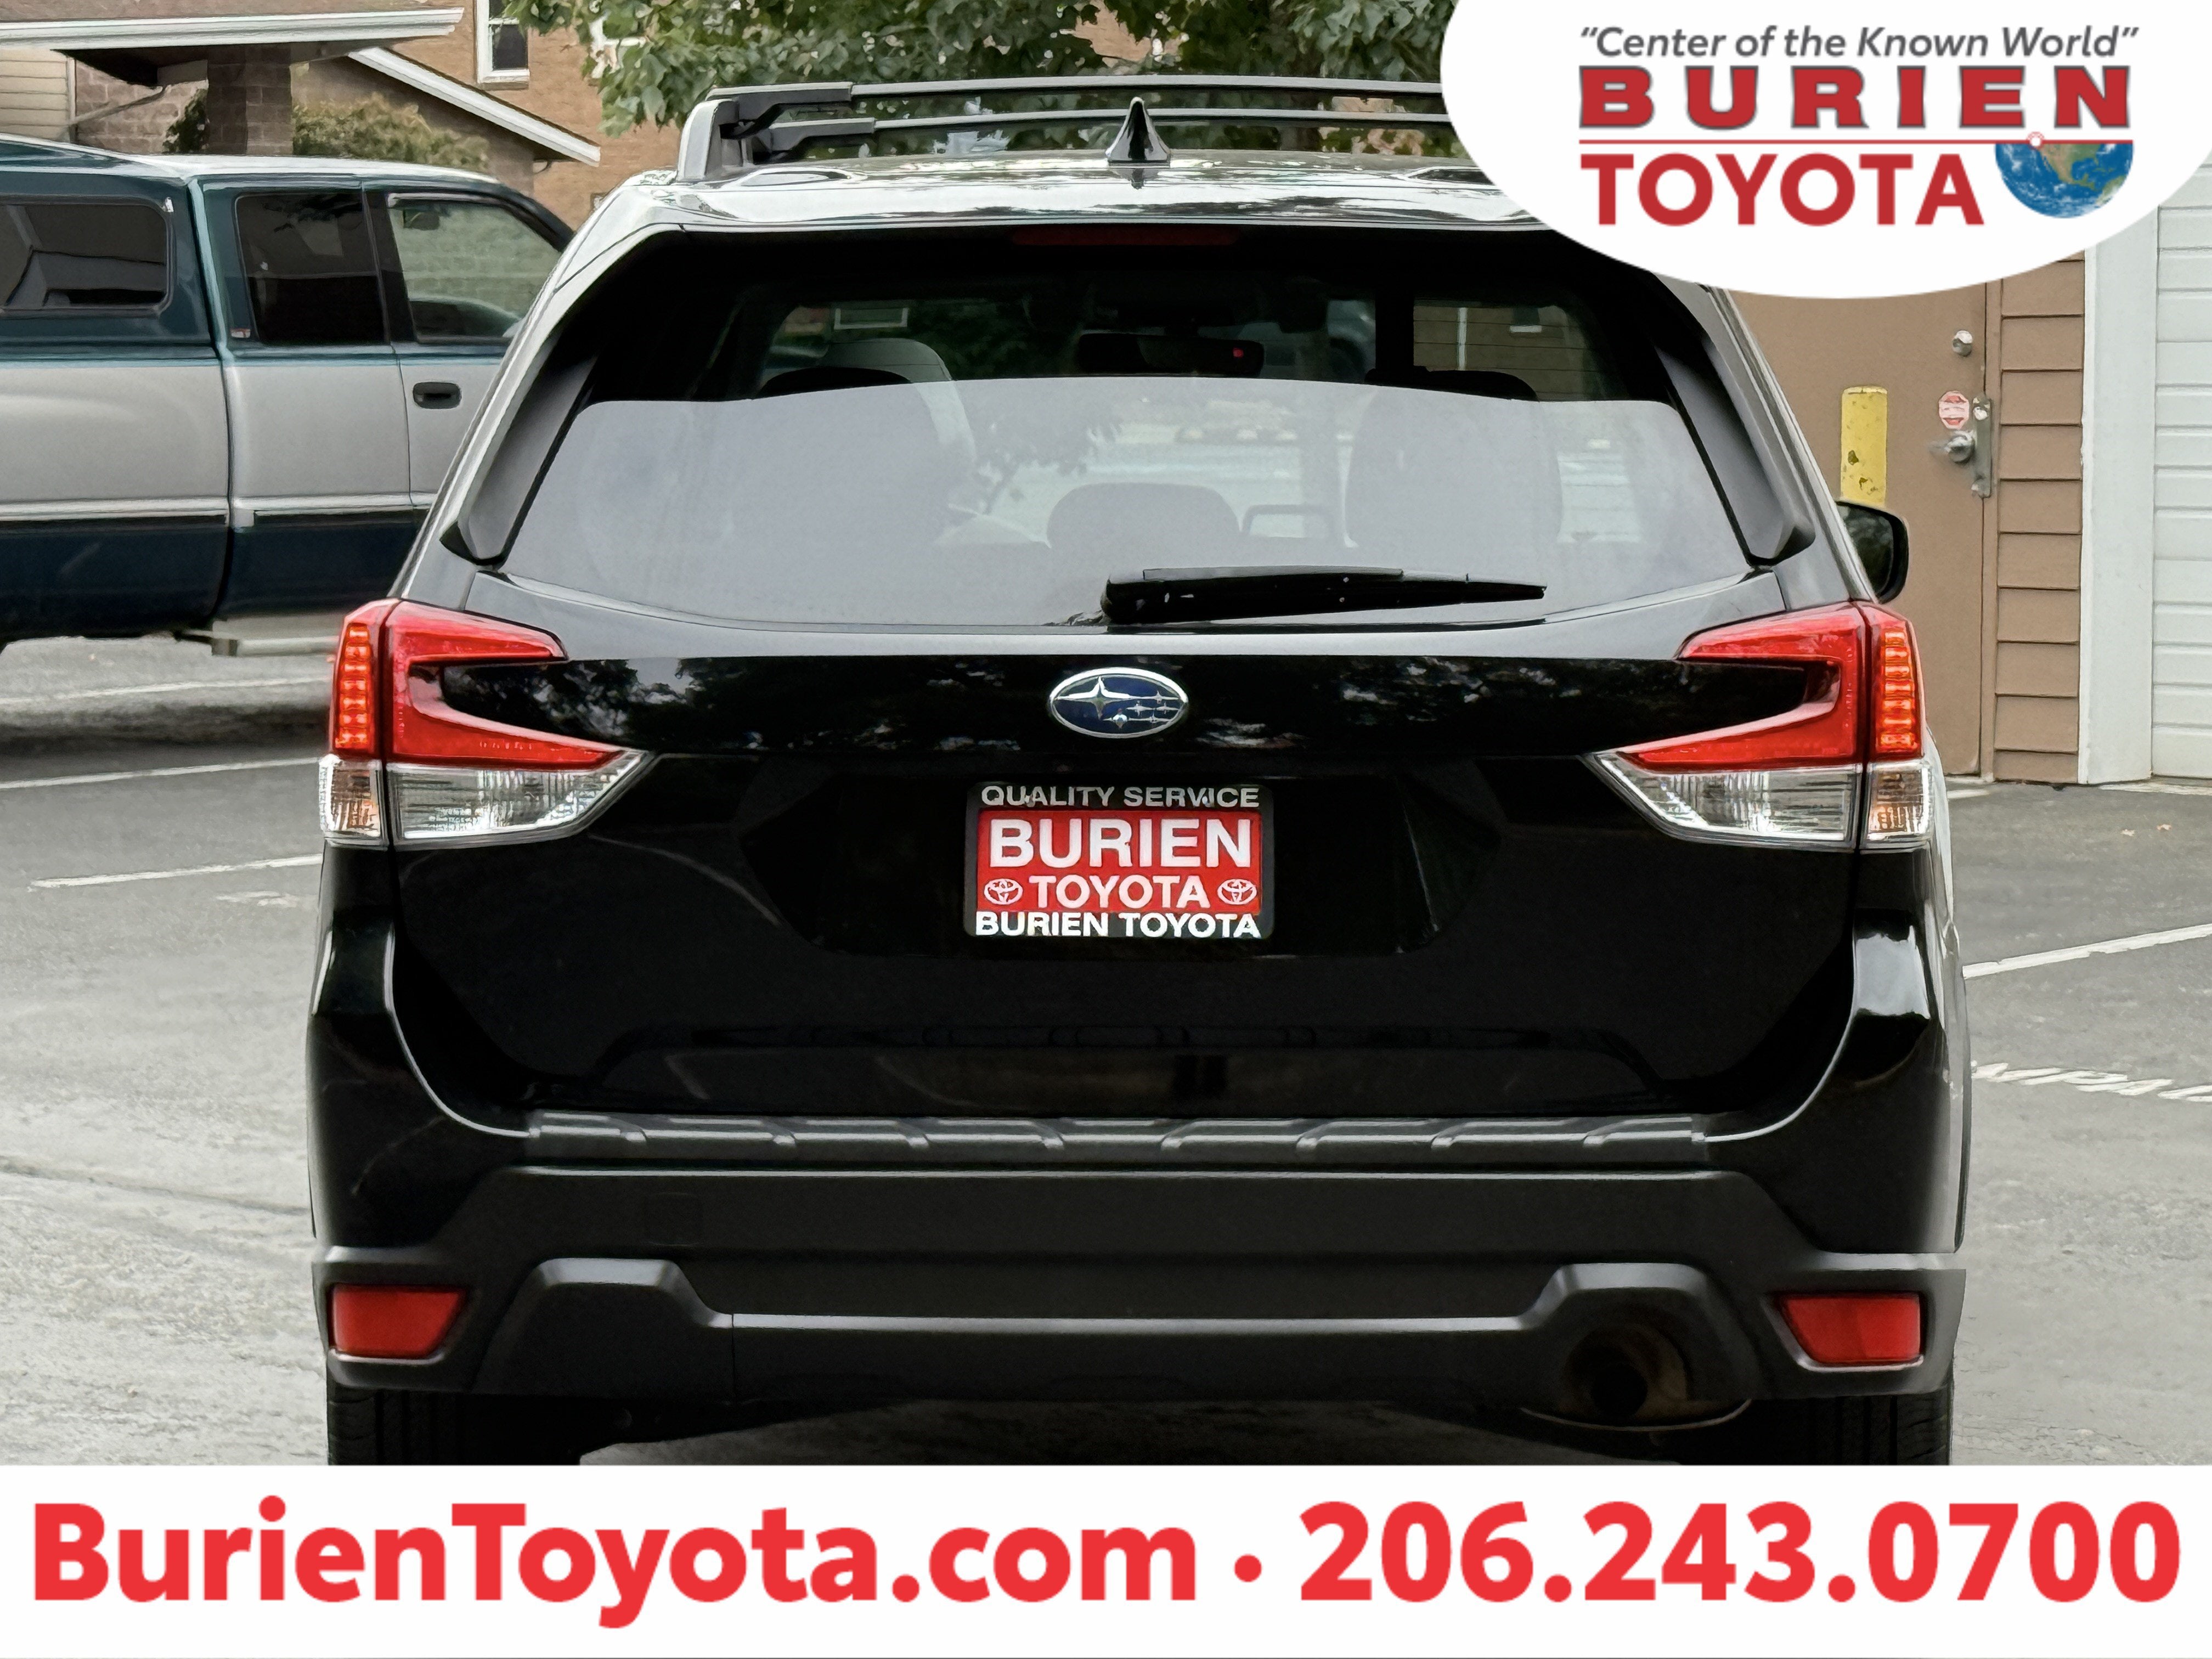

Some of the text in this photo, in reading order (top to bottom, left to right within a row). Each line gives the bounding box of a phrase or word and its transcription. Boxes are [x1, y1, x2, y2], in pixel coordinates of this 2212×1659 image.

[981, 786, 1260, 808] QUALITY SERVICE
[990, 818, 1251, 868] BURIEN
[1028, 874, 1211, 909] TOYOTA
[975, 912, 1262, 938] BURIEN TOYOTA
